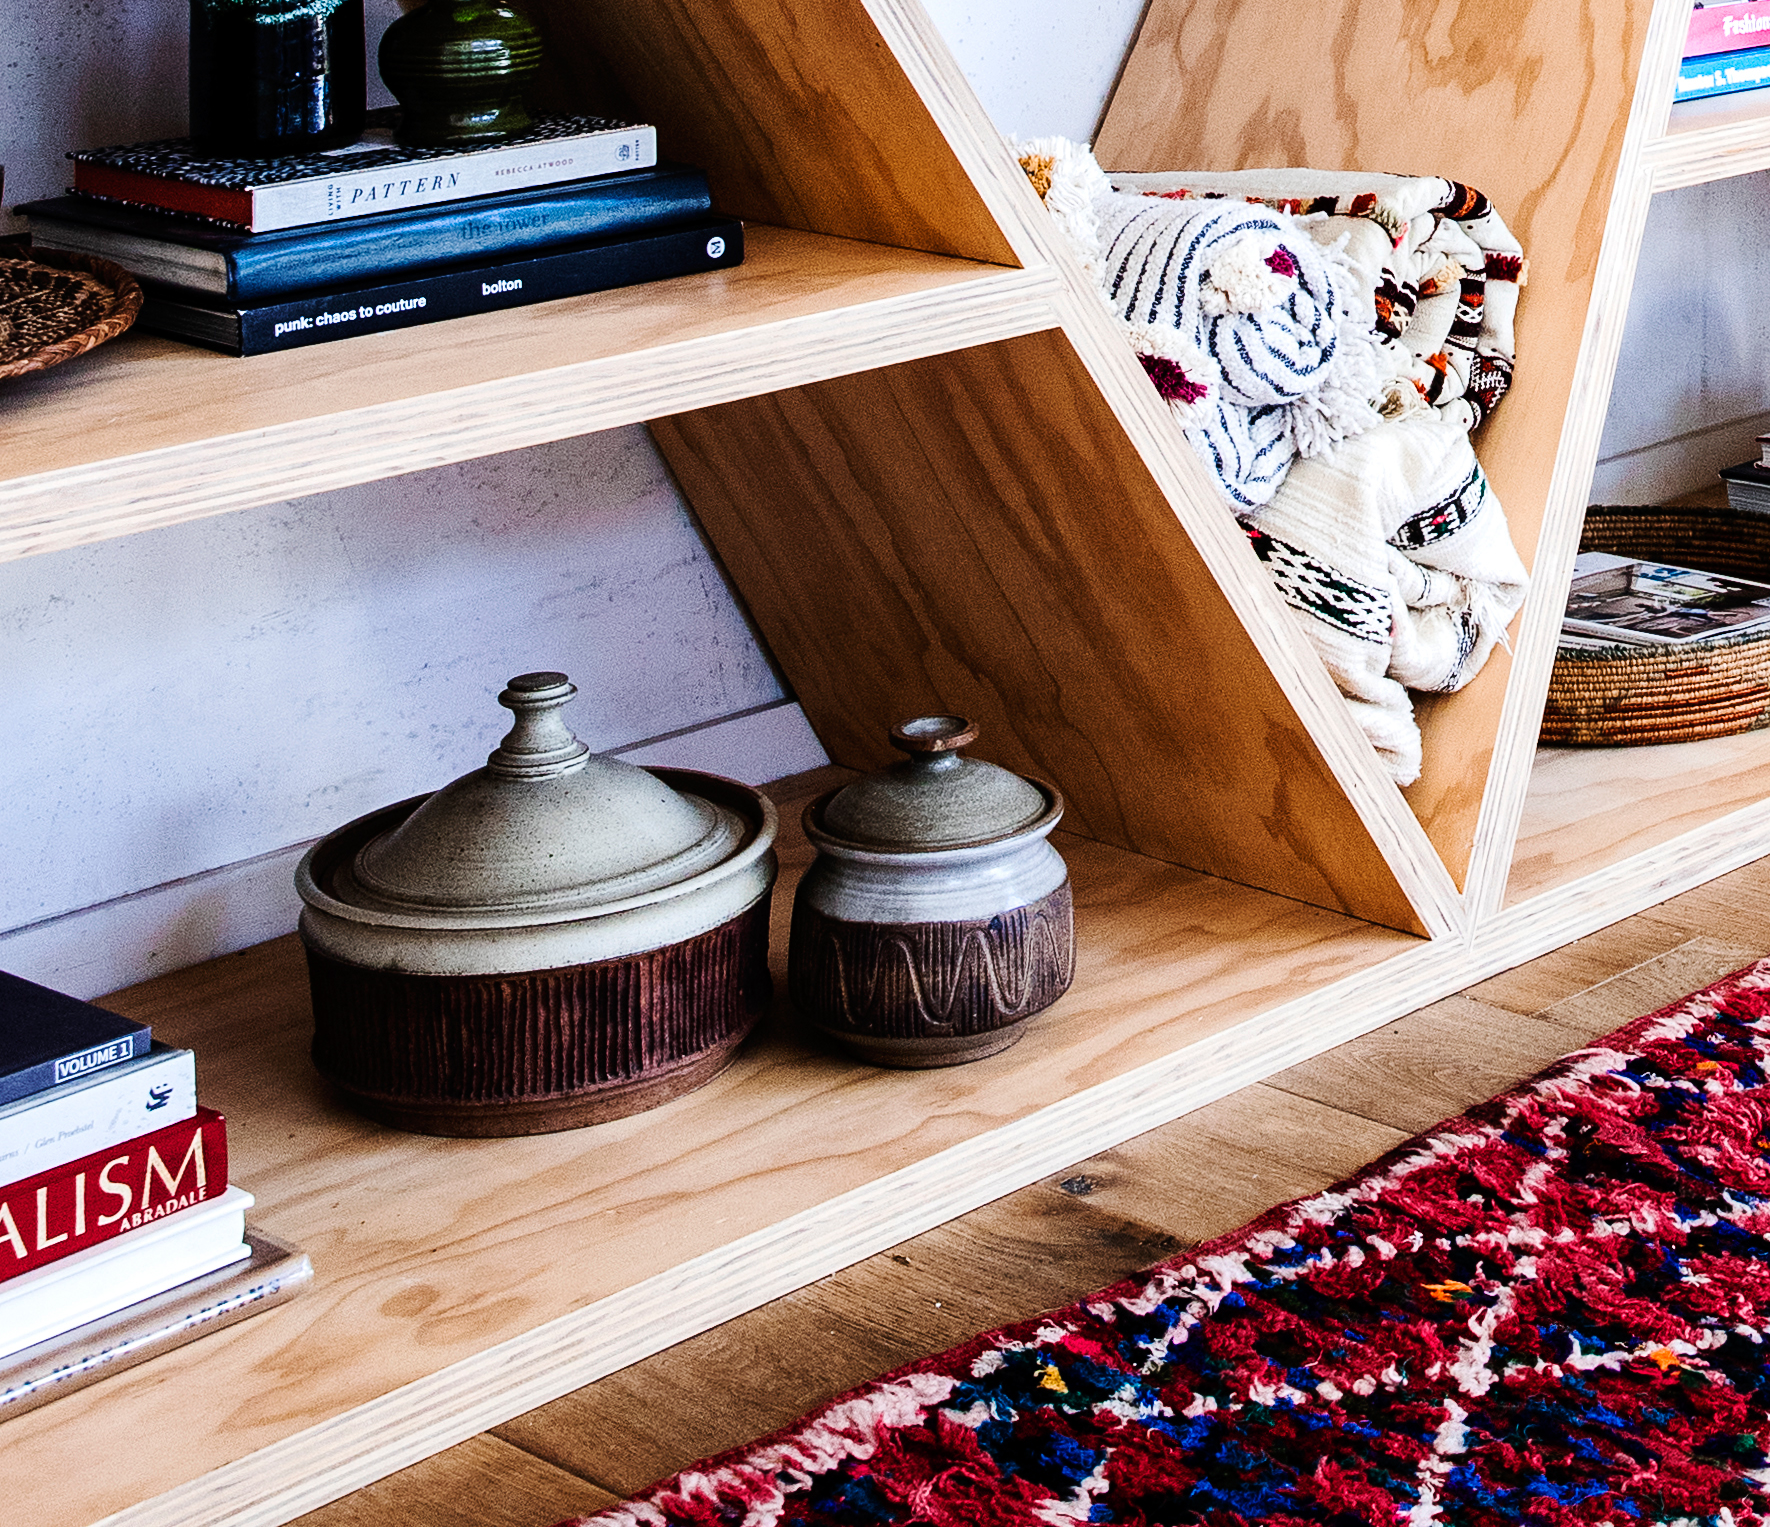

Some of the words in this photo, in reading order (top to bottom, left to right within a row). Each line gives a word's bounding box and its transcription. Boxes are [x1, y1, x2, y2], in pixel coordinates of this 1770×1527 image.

[495, 164, 534, 177] REBECCA
[537, 157, 574, 170] ATWOOD
[350, 171, 461, 205] PATTERN
[461, 220, 493, 241] the
[481, 278, 523, 296] bolton
[274, 315, 314, 338] punk:
[315, 308, 357, 327] chaos
[358, 305, 374, 319] to
[375, 296, 427, 316] couture
[59, 1046, 117, 1077] VOLUME
[117, 1042, 129, 1057] 1
[34, 1134, 56, 1150] Glen
[119, 1186, 207, 1234] ABRADALE
